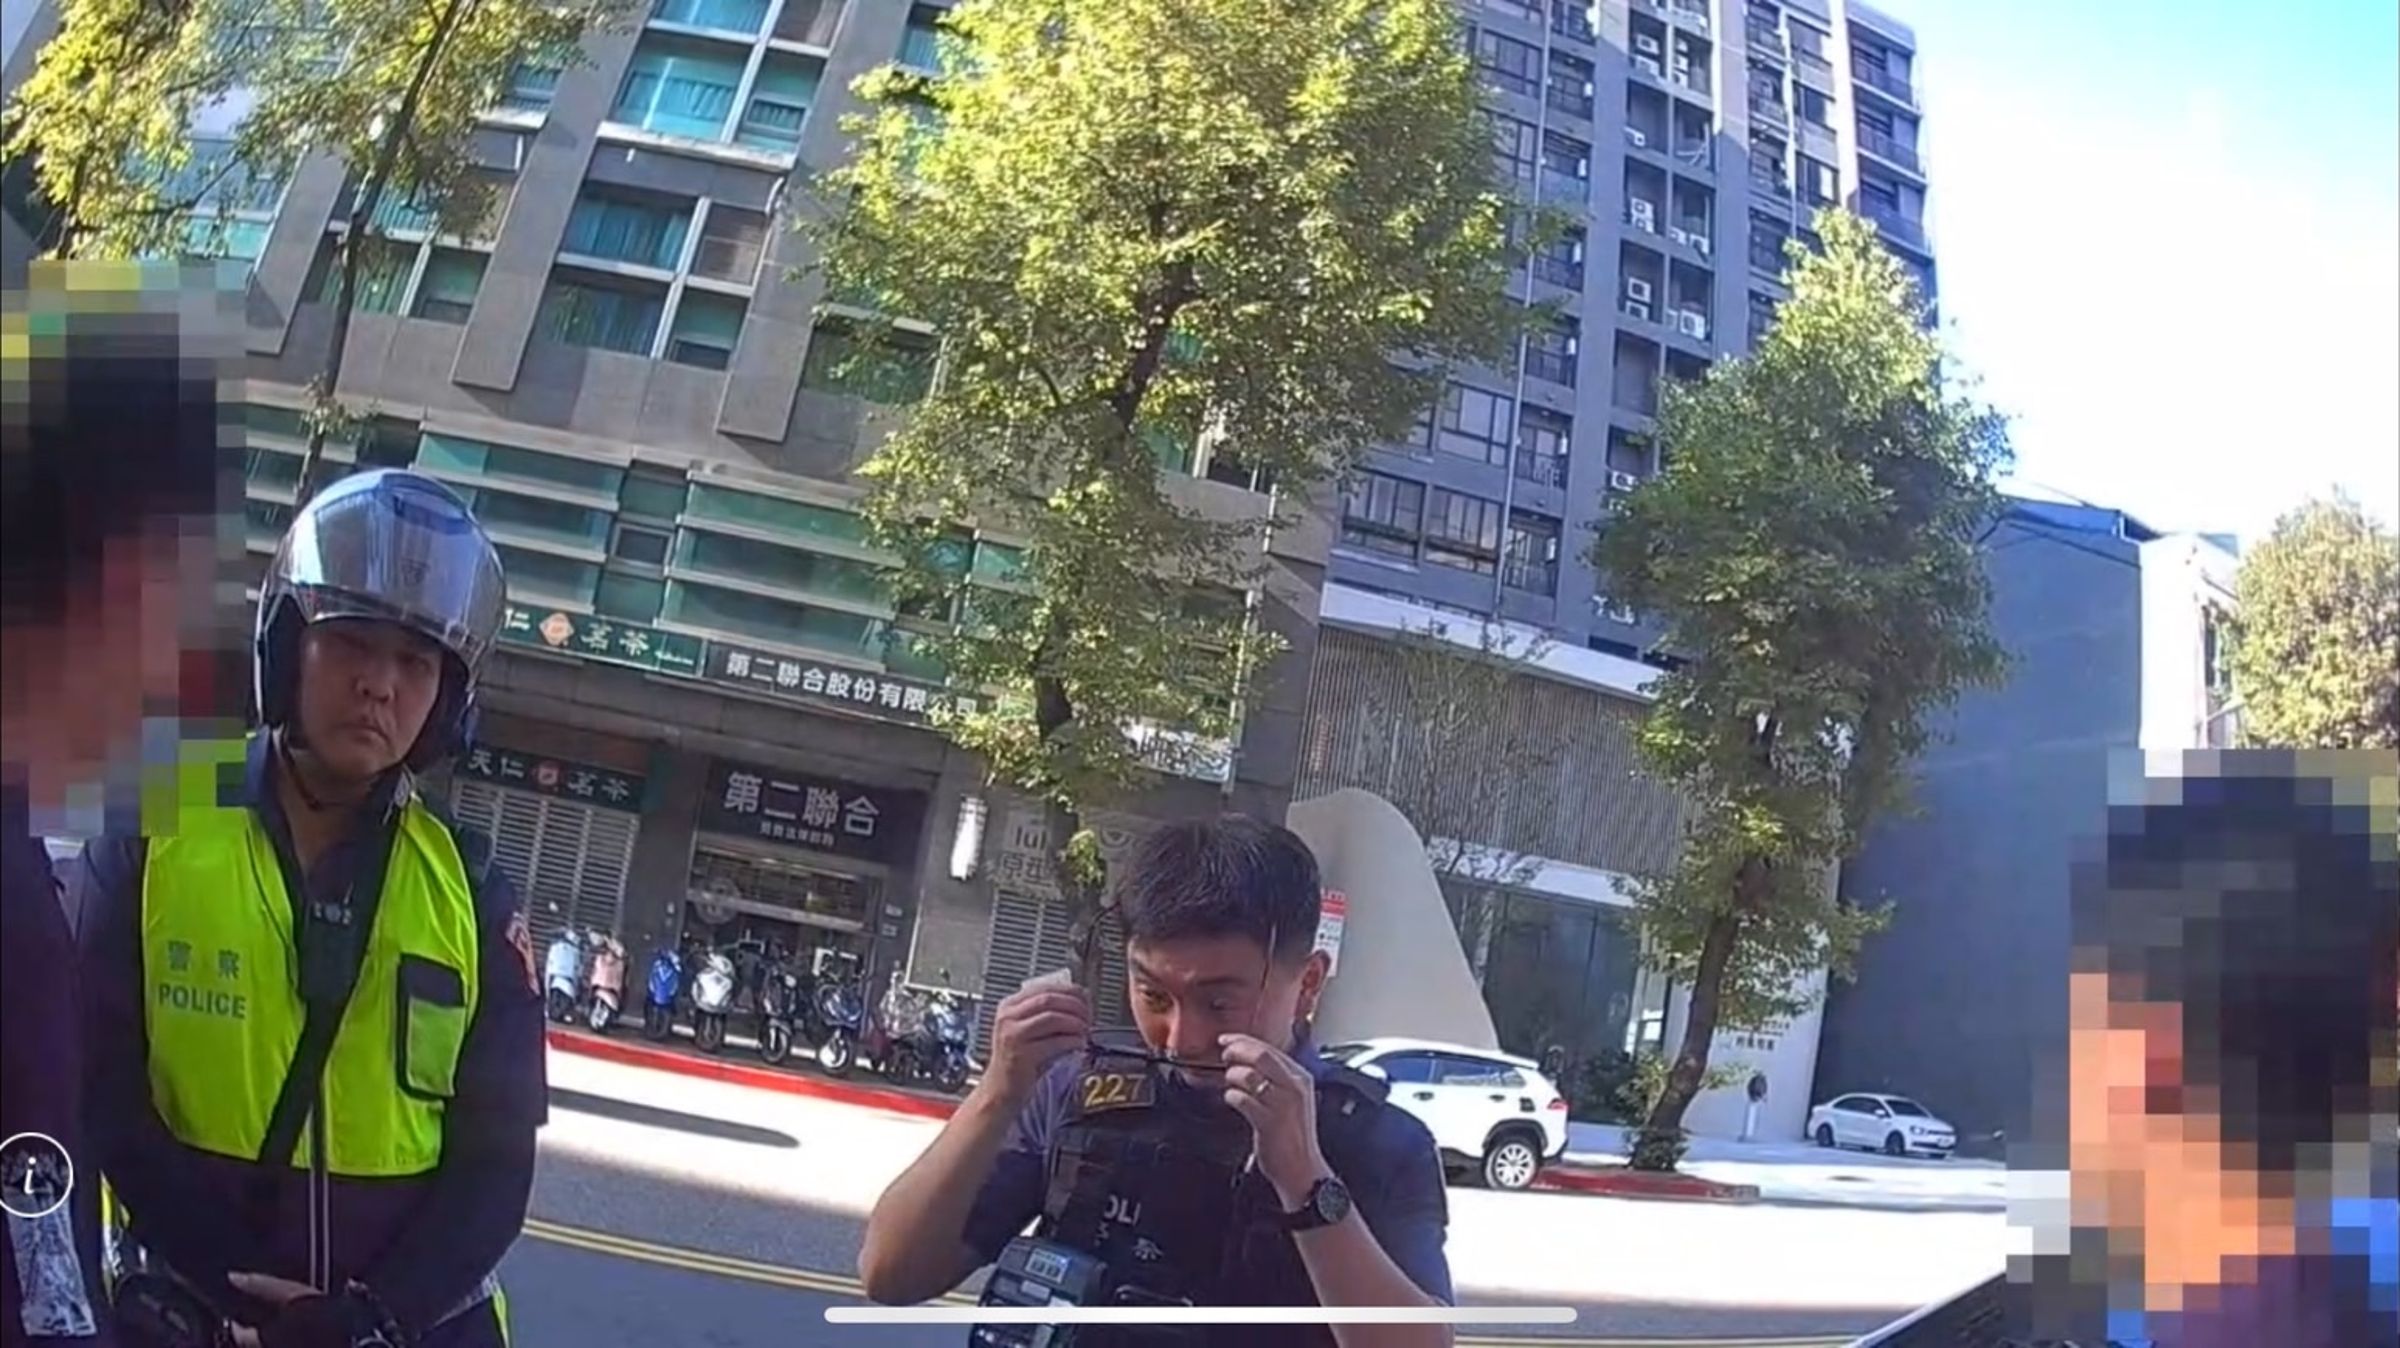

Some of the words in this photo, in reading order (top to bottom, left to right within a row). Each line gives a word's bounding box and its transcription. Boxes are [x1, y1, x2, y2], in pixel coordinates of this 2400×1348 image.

[468, 749, 525, 778] 天仁
[724, 771, 880, 837] 第二聯合
[158, 982, 247, 1020] POLICE
[1084, 1073, 1148, 1108] 227
